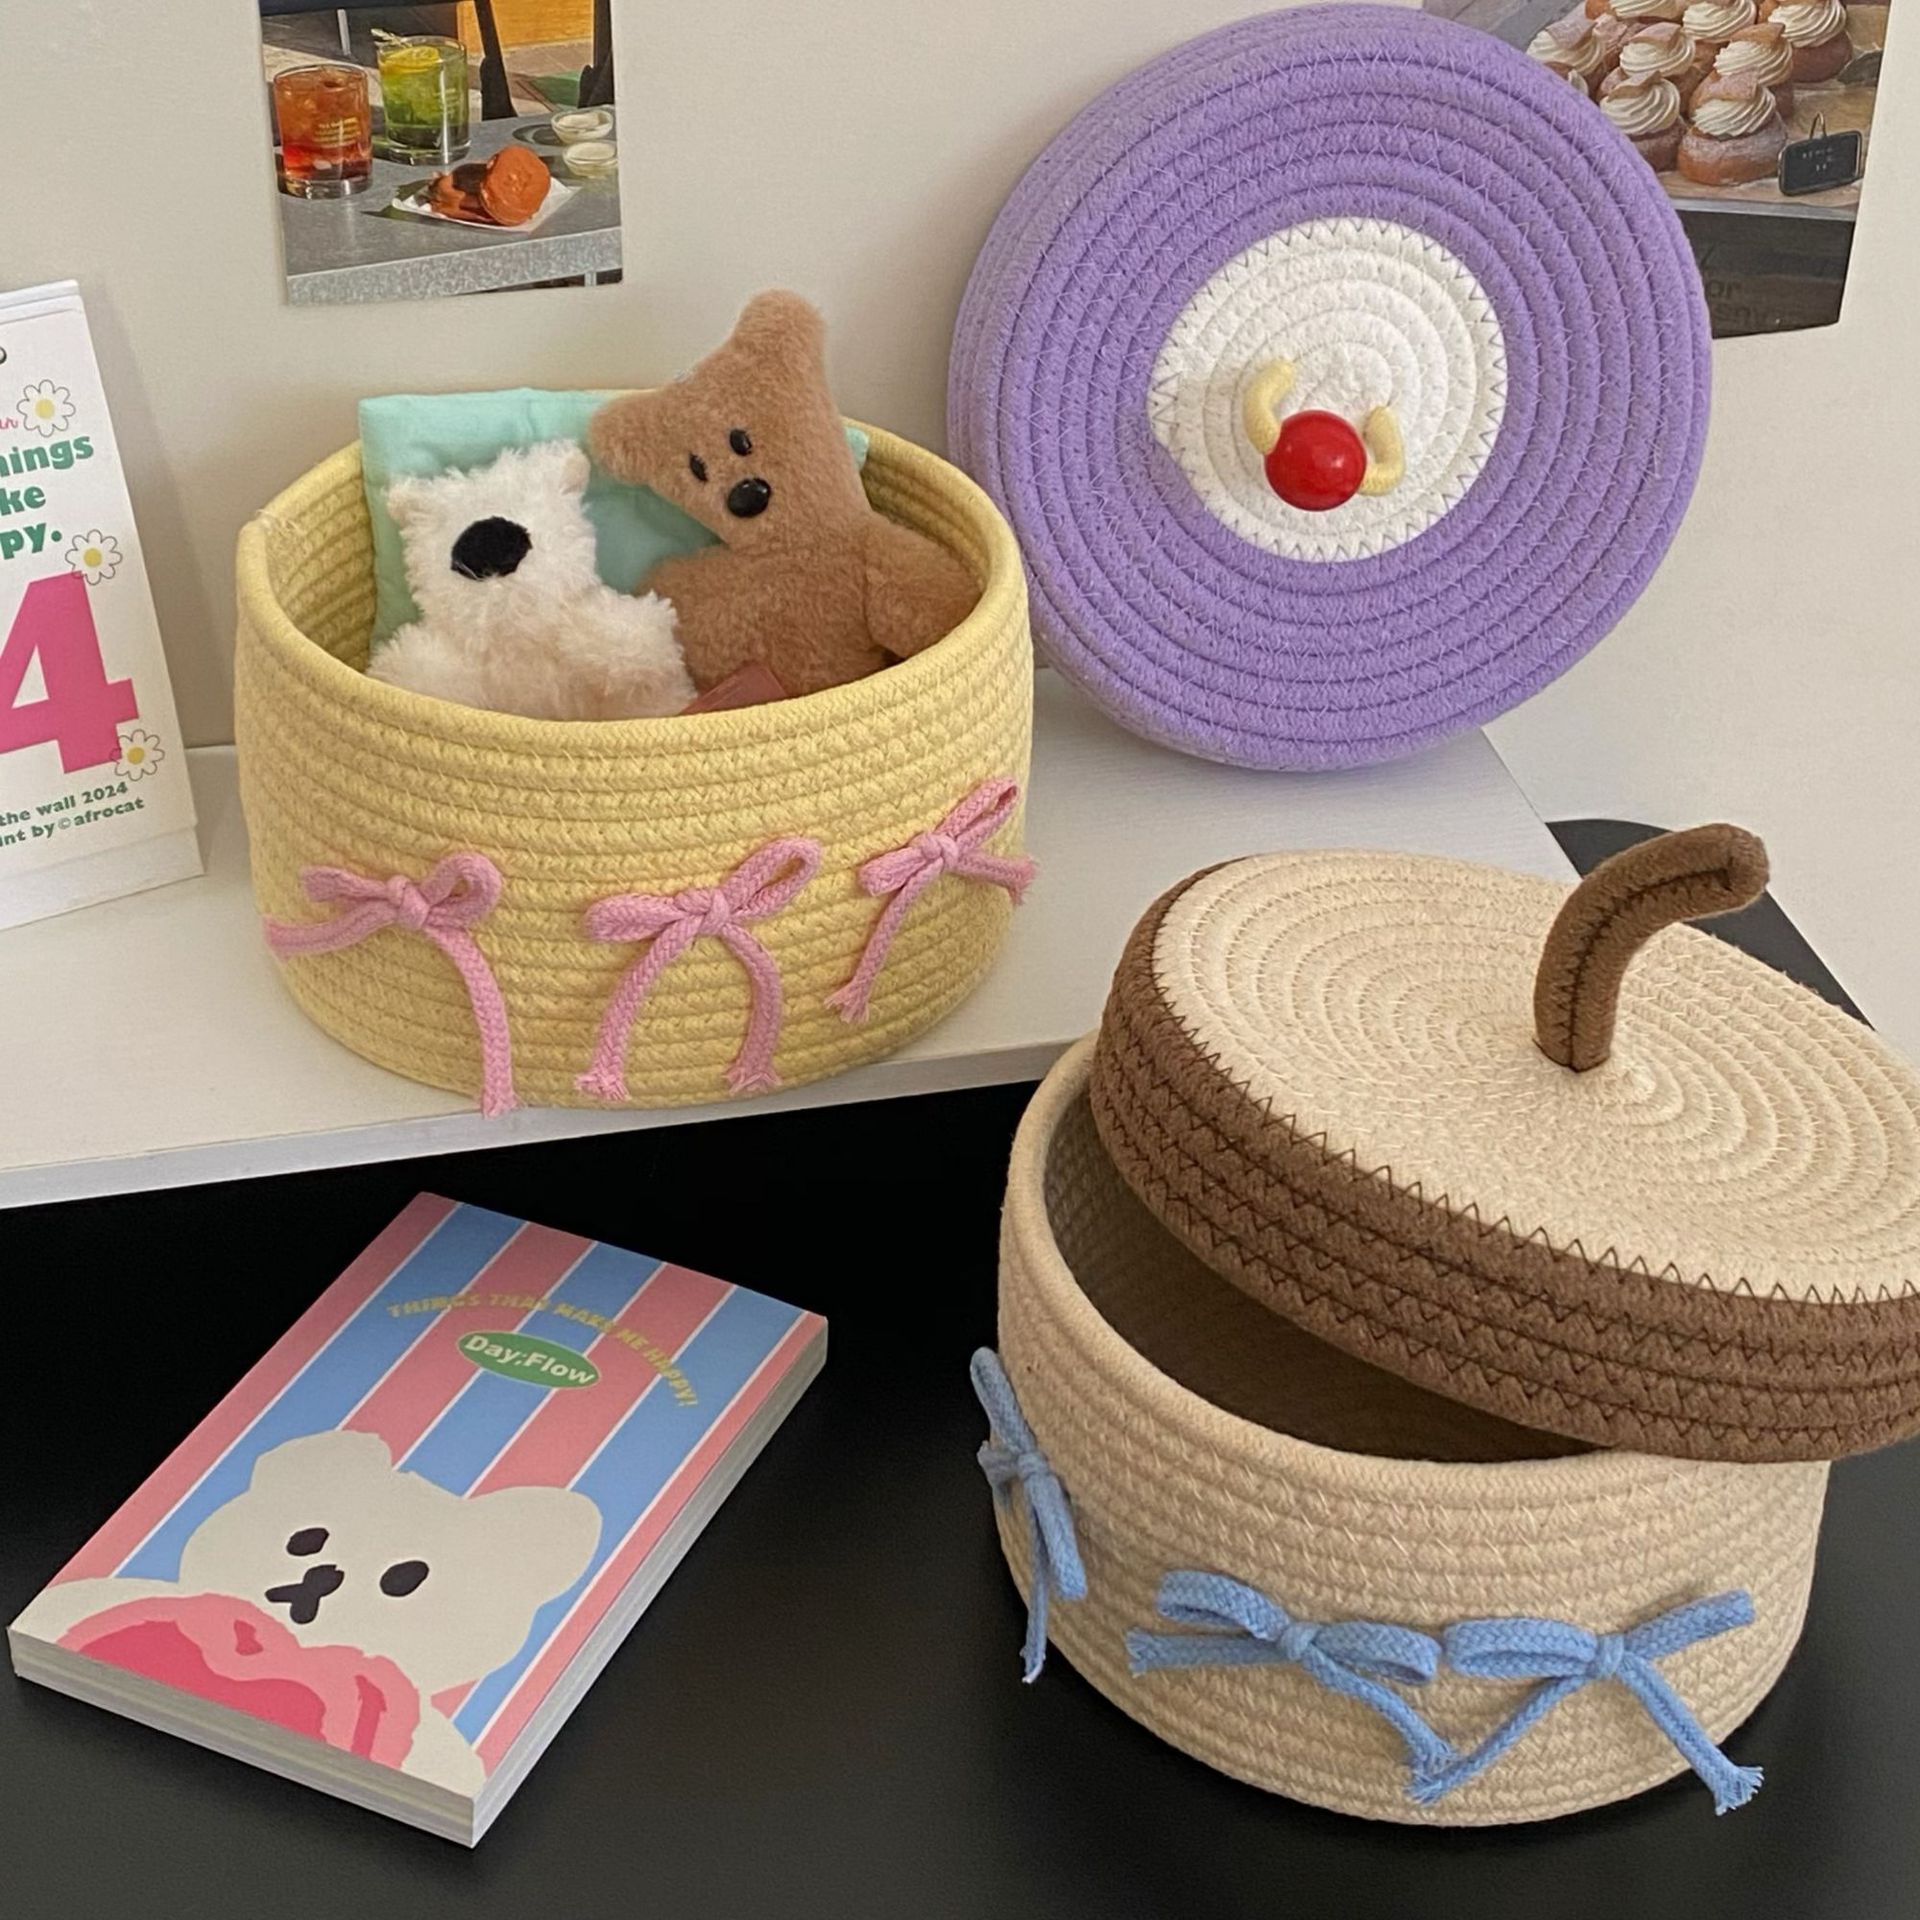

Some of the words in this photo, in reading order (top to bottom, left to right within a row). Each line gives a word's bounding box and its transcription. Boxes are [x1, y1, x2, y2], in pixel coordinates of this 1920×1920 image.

[0, 486, 46, 517] ke
[0, 522, 62, 560] py.
[0, 810, 31, 826] the
[36, 795, 76, 816] wall
[82, 781, 128, 804] 2024
